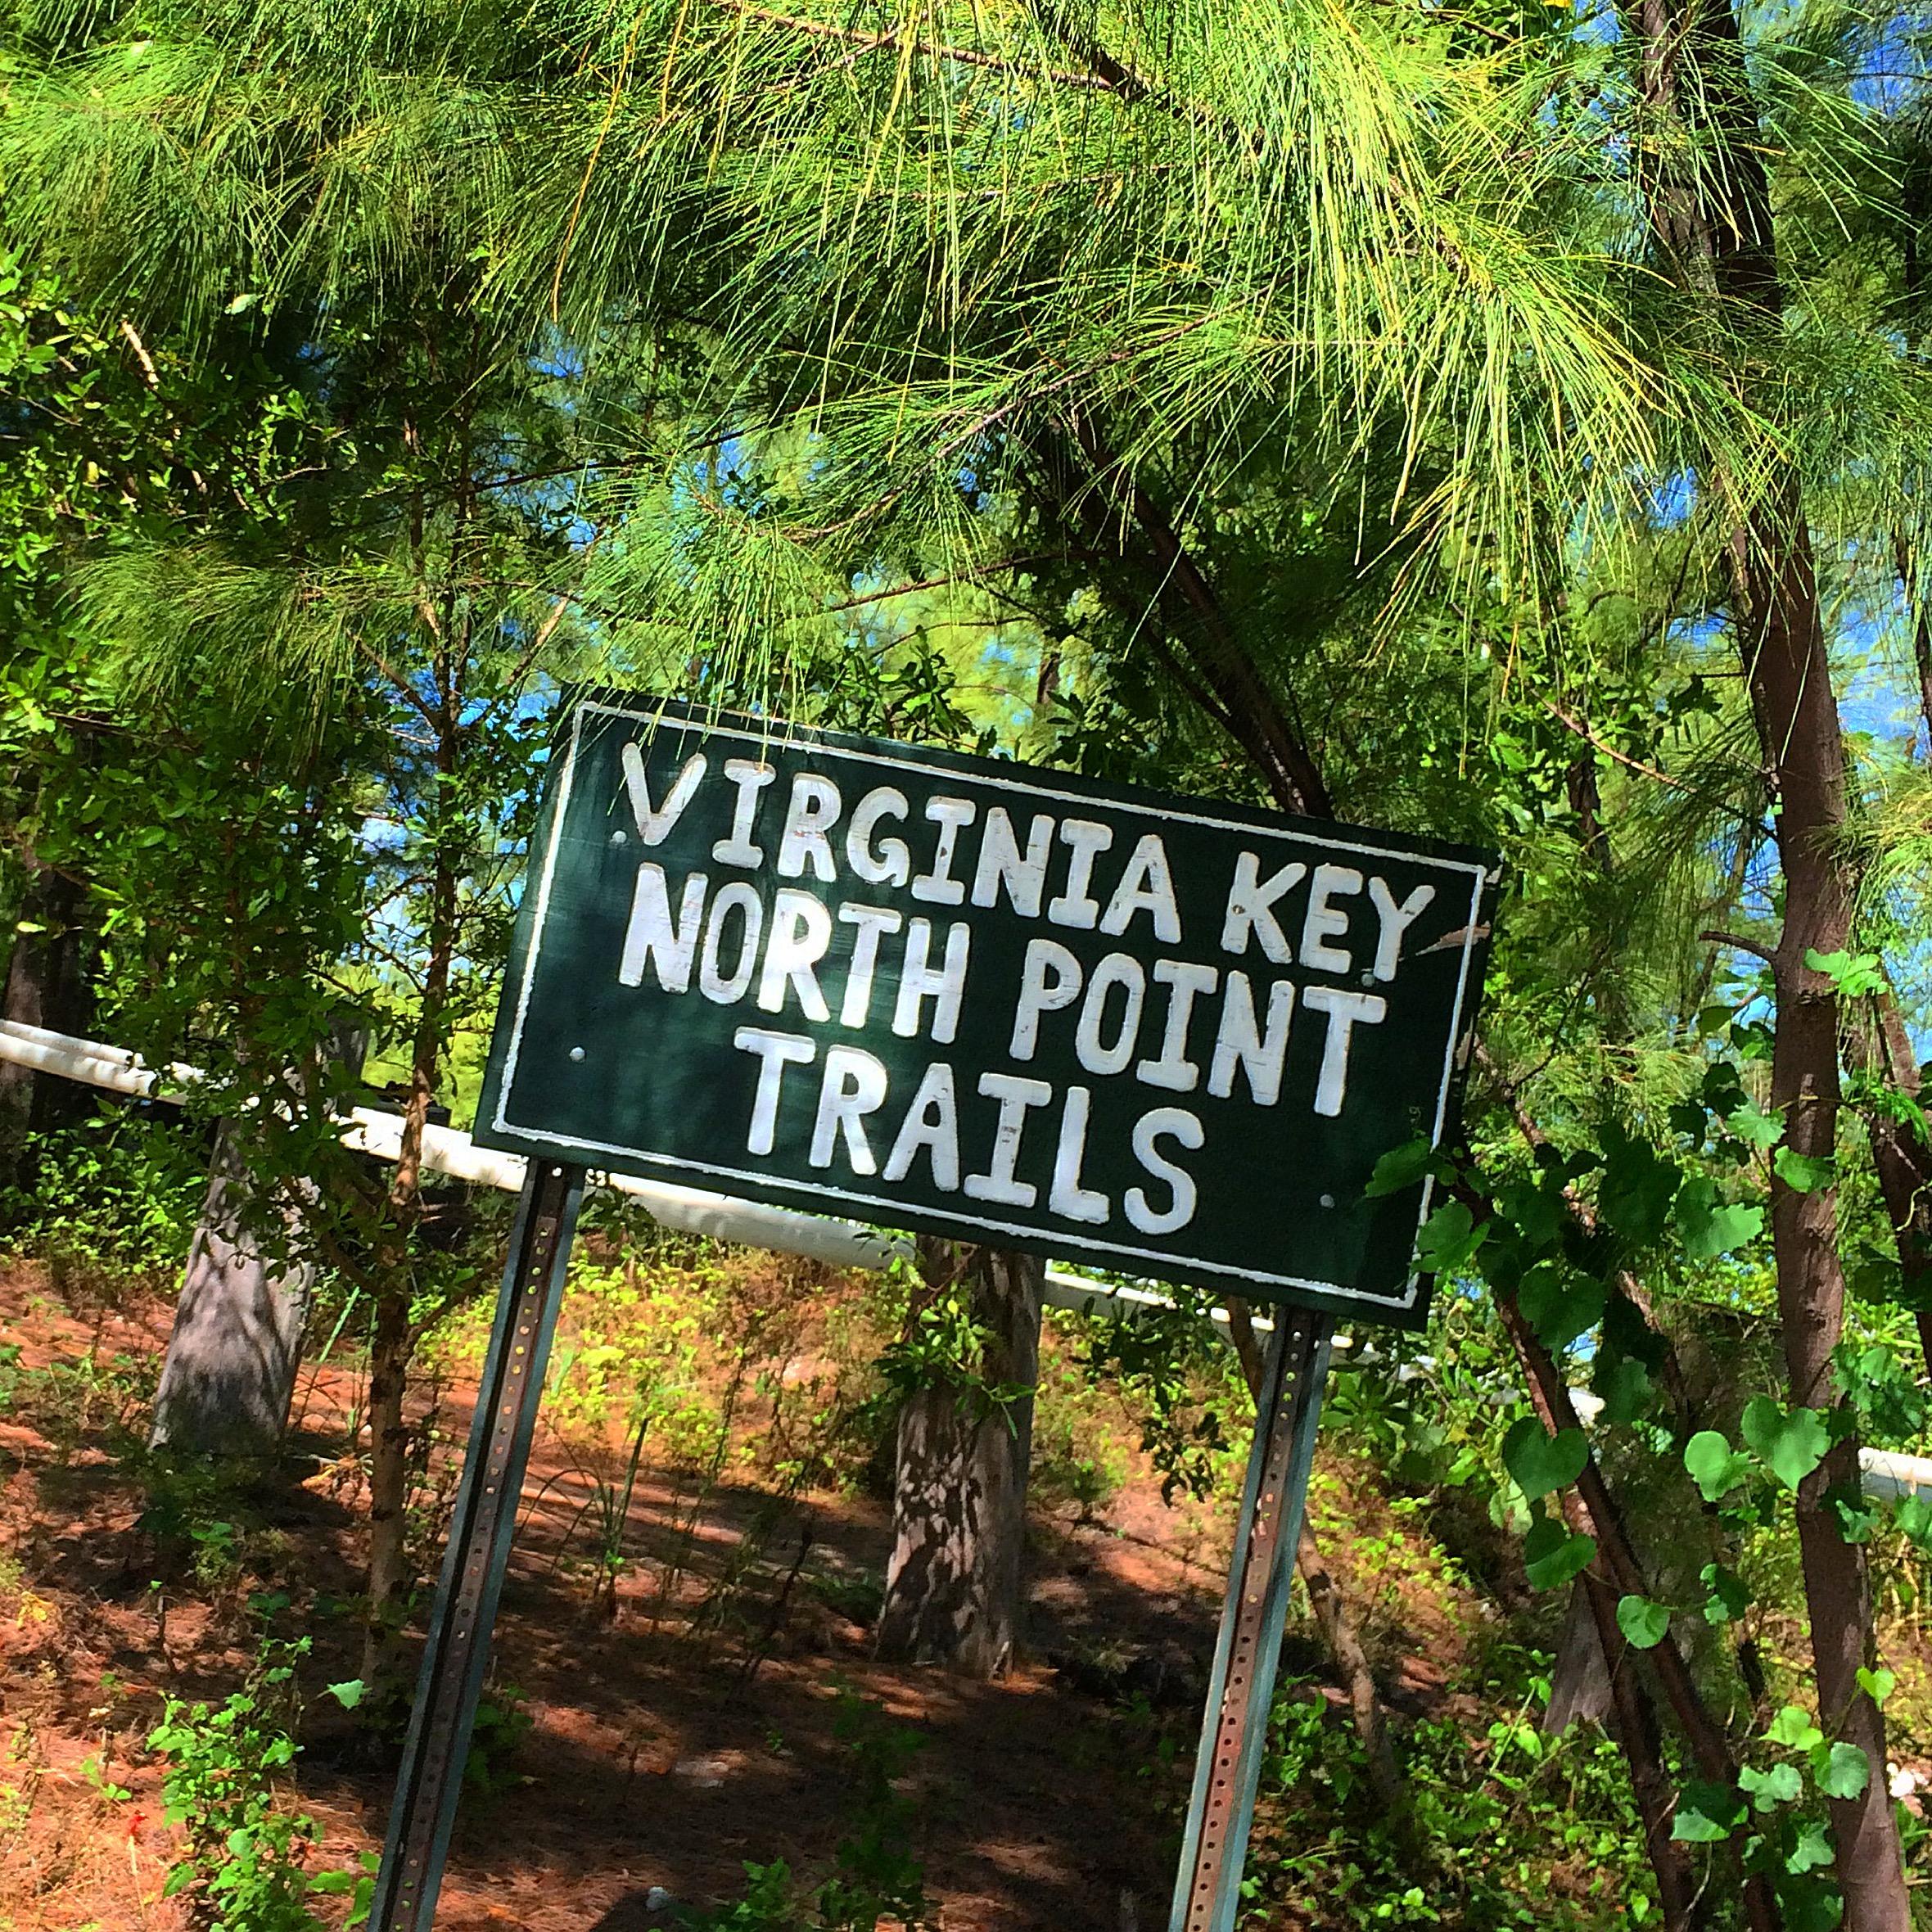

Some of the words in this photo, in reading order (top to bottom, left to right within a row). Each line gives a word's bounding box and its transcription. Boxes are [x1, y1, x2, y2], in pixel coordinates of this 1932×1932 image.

[621, 741, 1182, 945] VIRGINIA
[1220, 851, 1437, 982] KEY
[617, 860, 971, 1045] NORTH
[1008, 937, 1387, 1117] POINT
[733, 1025, 1206, 1235] TRAILS
